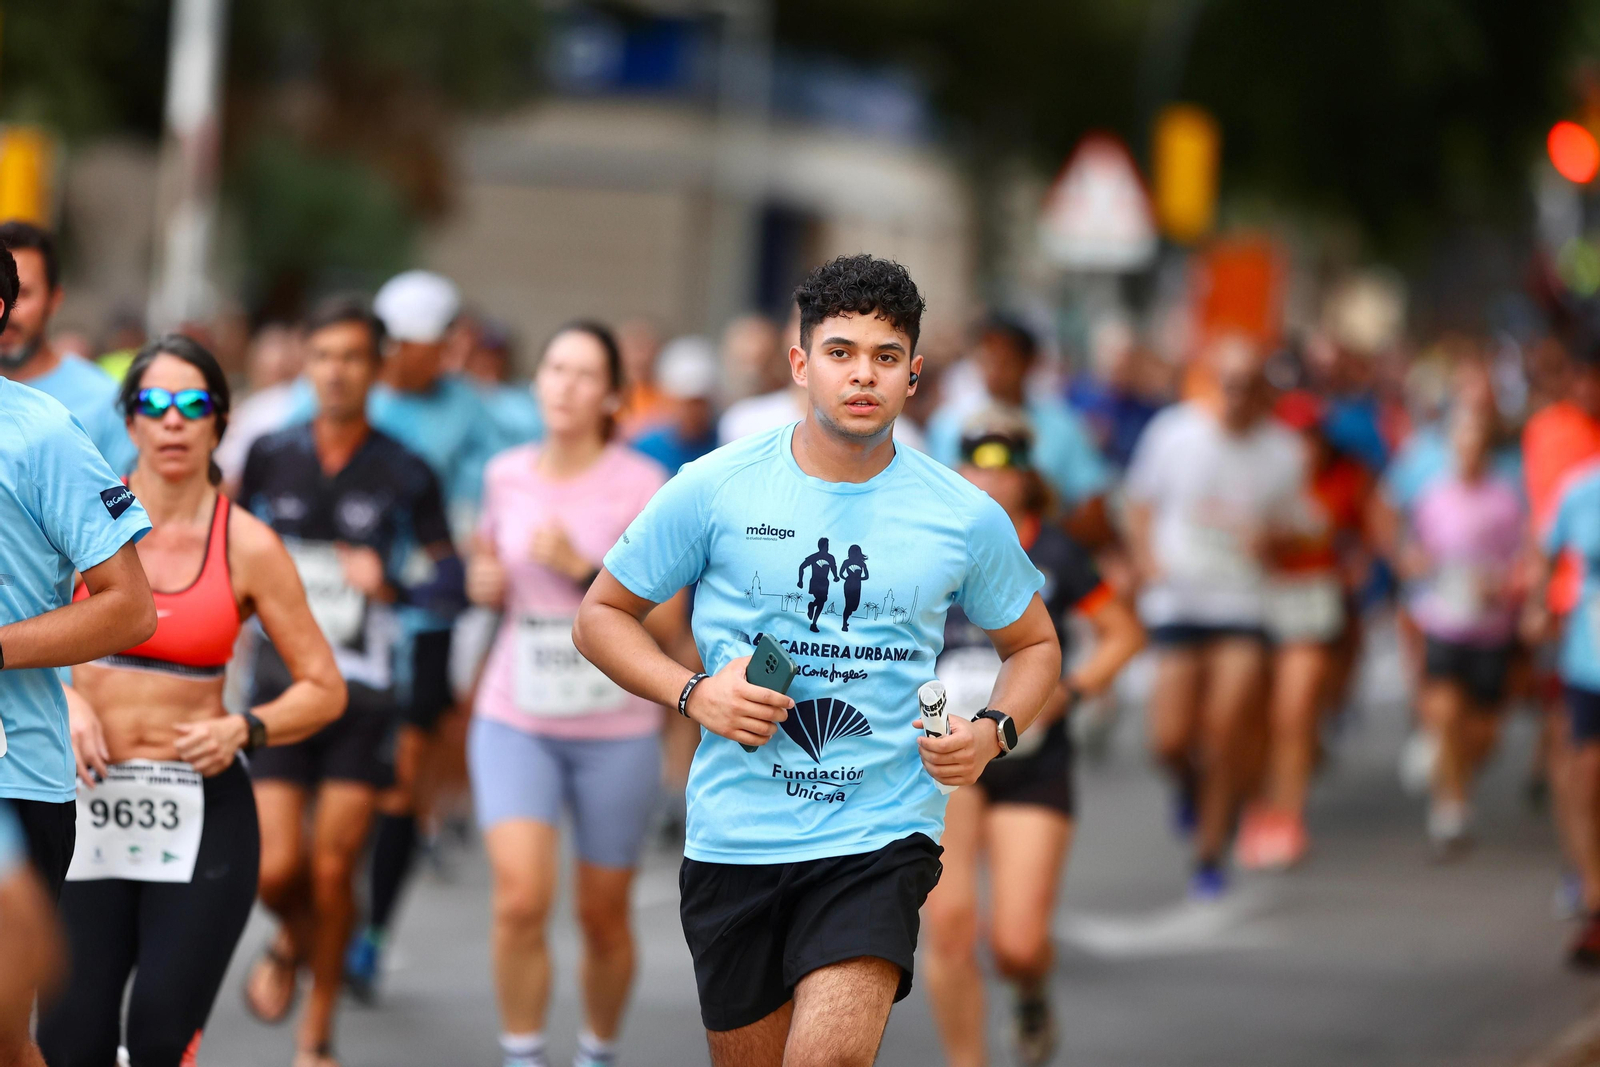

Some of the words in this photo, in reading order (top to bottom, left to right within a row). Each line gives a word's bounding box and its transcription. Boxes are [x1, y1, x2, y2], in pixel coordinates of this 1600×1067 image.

[854, 646, 909, 662] URBANA
[802, 664, 829, 678] Corte
[829, 663, 868, 683] Inglés
[772, 763, 864, 781] Fundación
[786, 781, 846, 804] Unicaja
[90, 798, 179, 830] 9633
